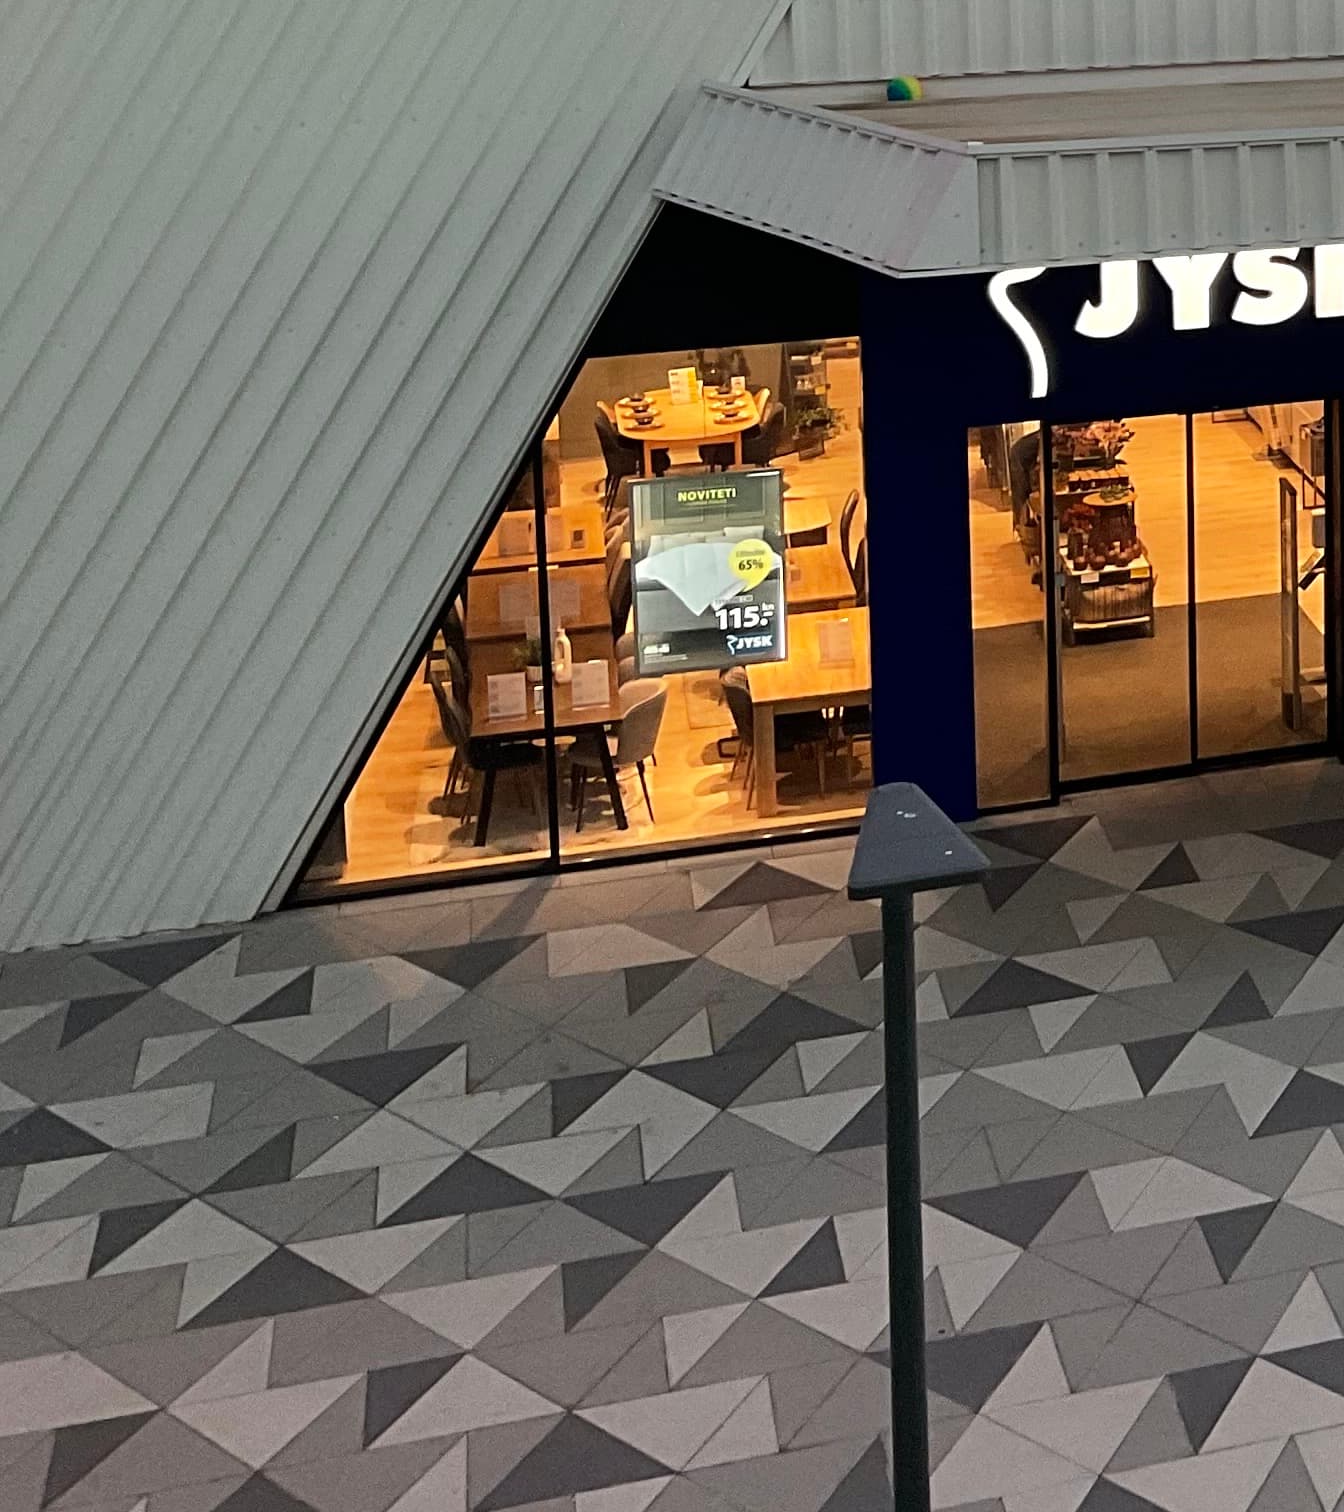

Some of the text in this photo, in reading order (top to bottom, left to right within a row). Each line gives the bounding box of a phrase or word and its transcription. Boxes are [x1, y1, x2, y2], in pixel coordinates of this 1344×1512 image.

[678, 487, 737, 502] NOVITETI
[738, 558, 763, 571] 65%
[737, 635, 773, 649] JYSK
